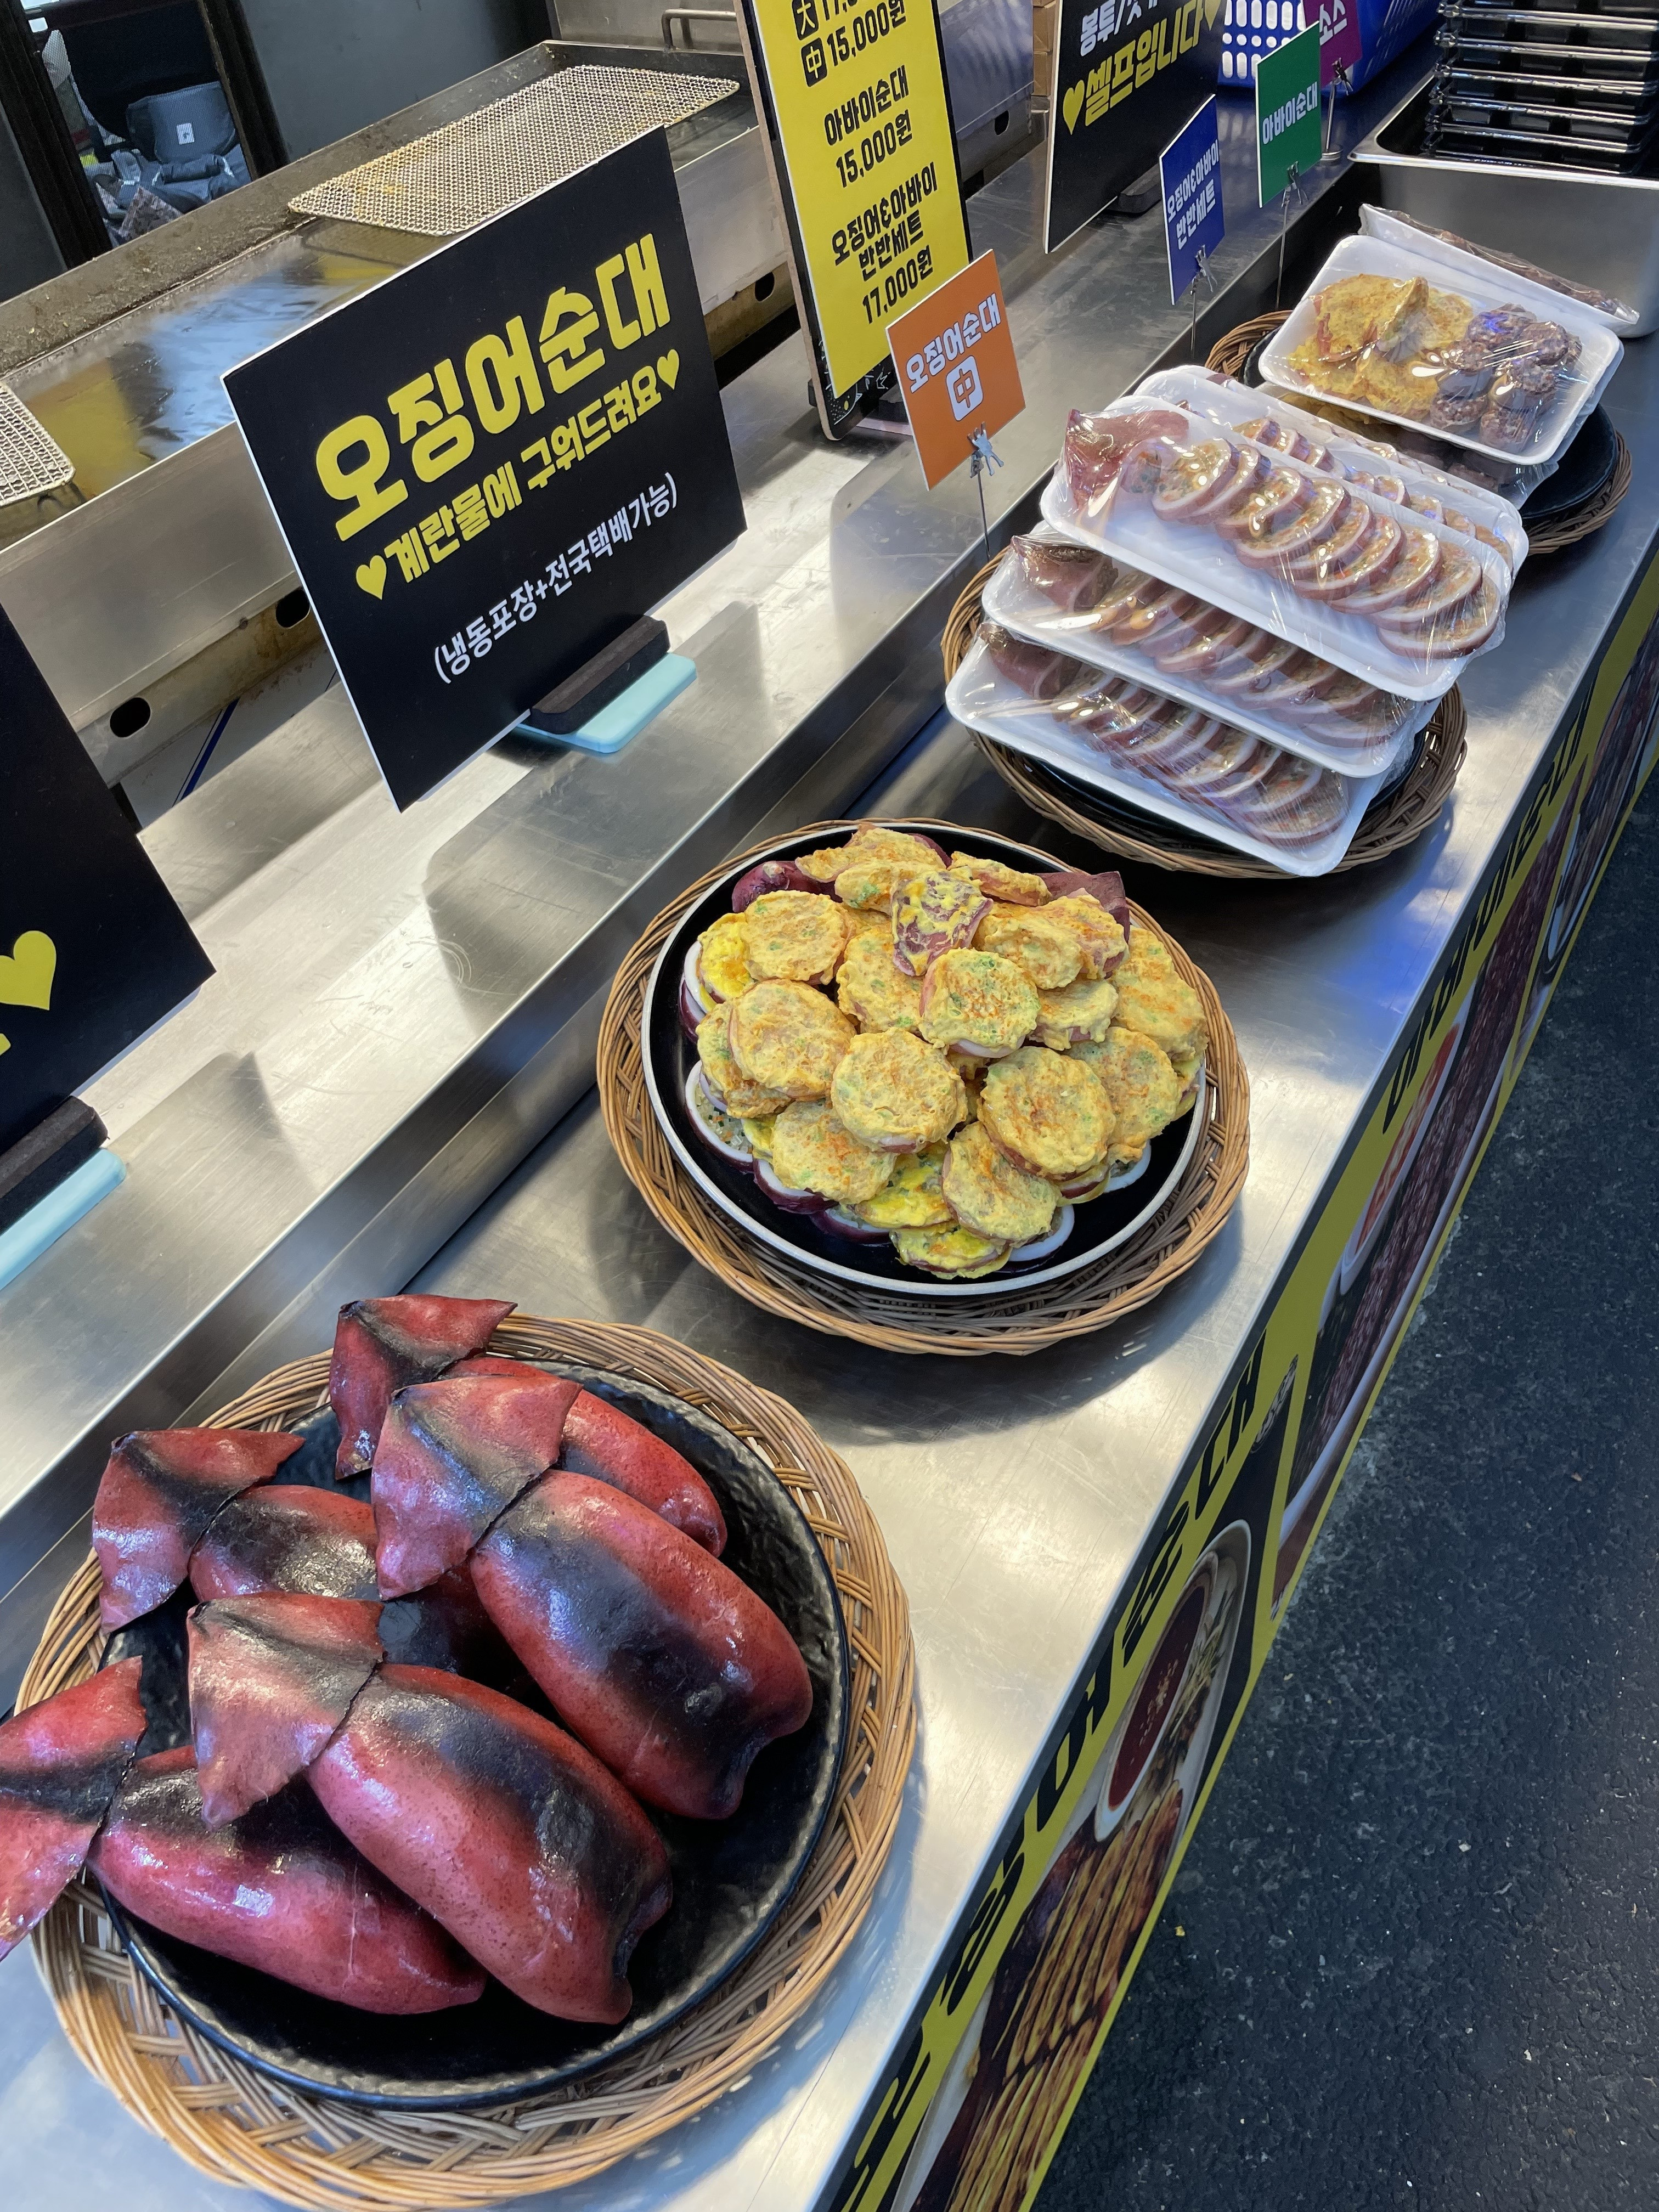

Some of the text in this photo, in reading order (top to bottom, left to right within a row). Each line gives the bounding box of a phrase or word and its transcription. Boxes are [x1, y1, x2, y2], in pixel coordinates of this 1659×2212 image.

[827, 0, 906, 66] 15,000원
[1319, 0, 1347, 46] 소스
[1085, 0, 1203, 126] 셀프입니다
[825, 65, 909, 145] 아바이순대
[1263, 81, 1317, 144] 아바이순대
[836, 109, 912, 188] 15,000원
[1167, 139, 1218, 223] 오징어&아바이
[832, 162, 937, 266] 오징어&아바이
[859, 210, 923, 281] 반반세트
[1176, 178, 1216, 250] 반반세트
[862, 245, 933, 324] 17,000원
[906, 293, 1001, 393] 오징어순대
[316, 234, 670, 541] 오징어순대
[951, 364, 978, 411] 中
[385, 366, 661, 583] 계란물에 구워드려요
[435, 472, 677, 684] (냉동포장+전국택배가능)
